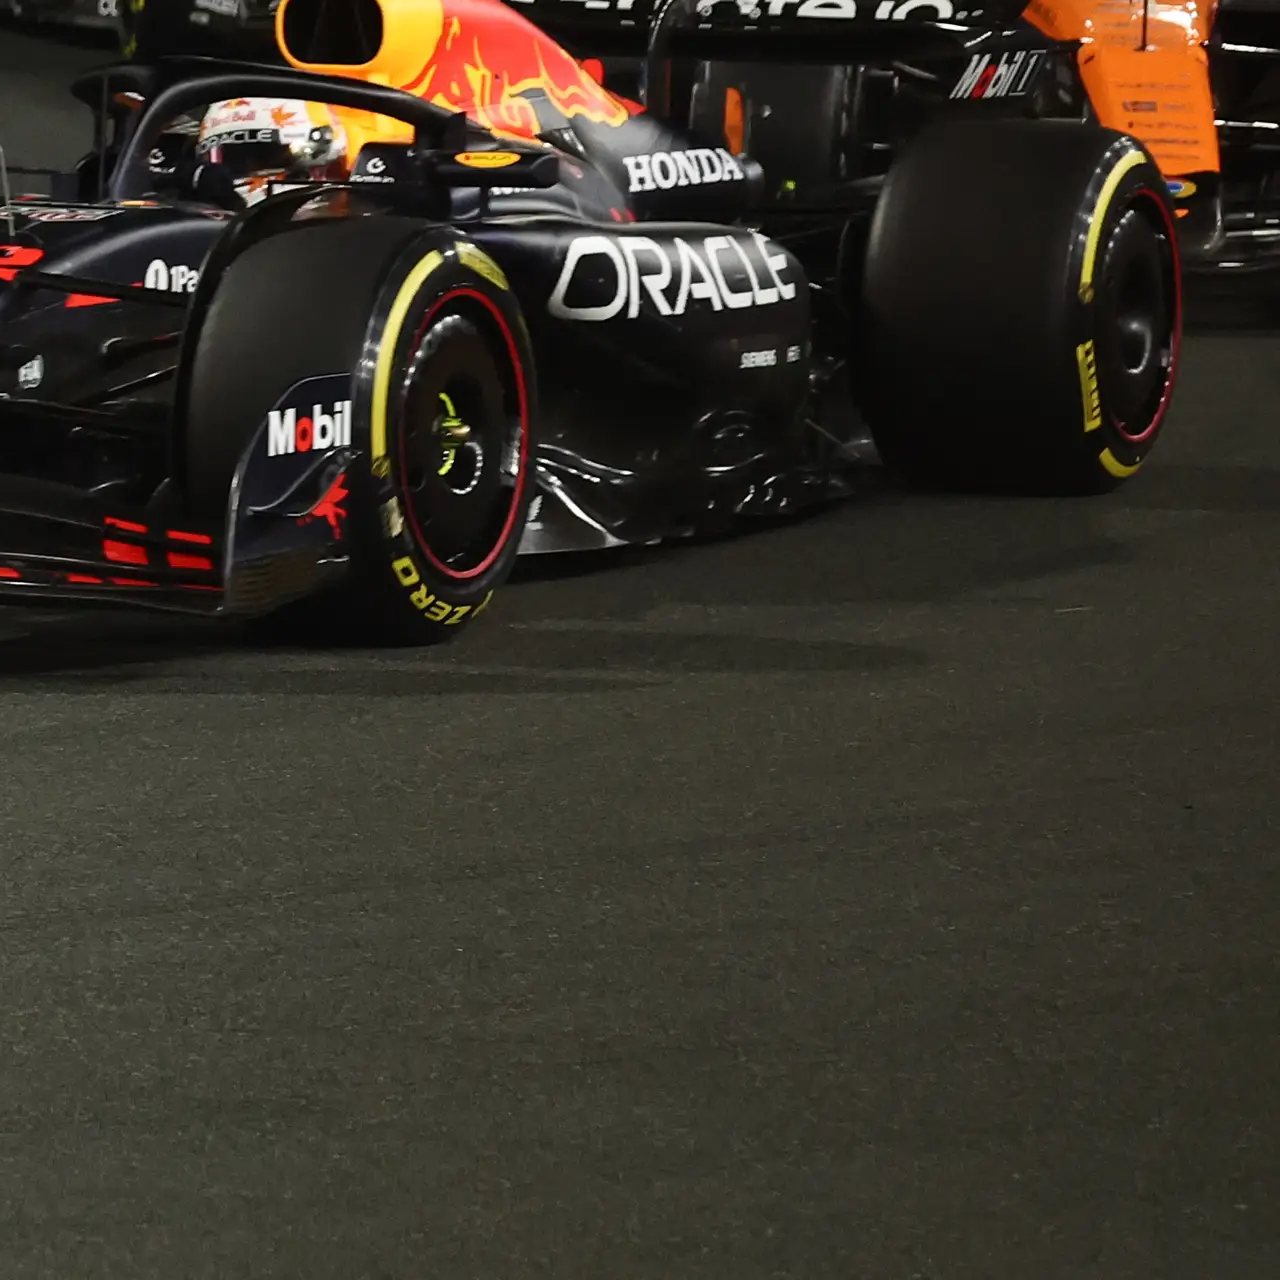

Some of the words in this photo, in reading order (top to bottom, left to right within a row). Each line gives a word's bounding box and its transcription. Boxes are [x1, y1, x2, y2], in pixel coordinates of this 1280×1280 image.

[949, 52, 1024, 100] Mobil
[195, 128, 273, 154] ORACLE
[622, 146, 745, 194] HONDA
[547, 230, 797, 322] ORACLE
[266, 400, 353, 457] Mobil
[390, 555, 473, 626] ZERO
